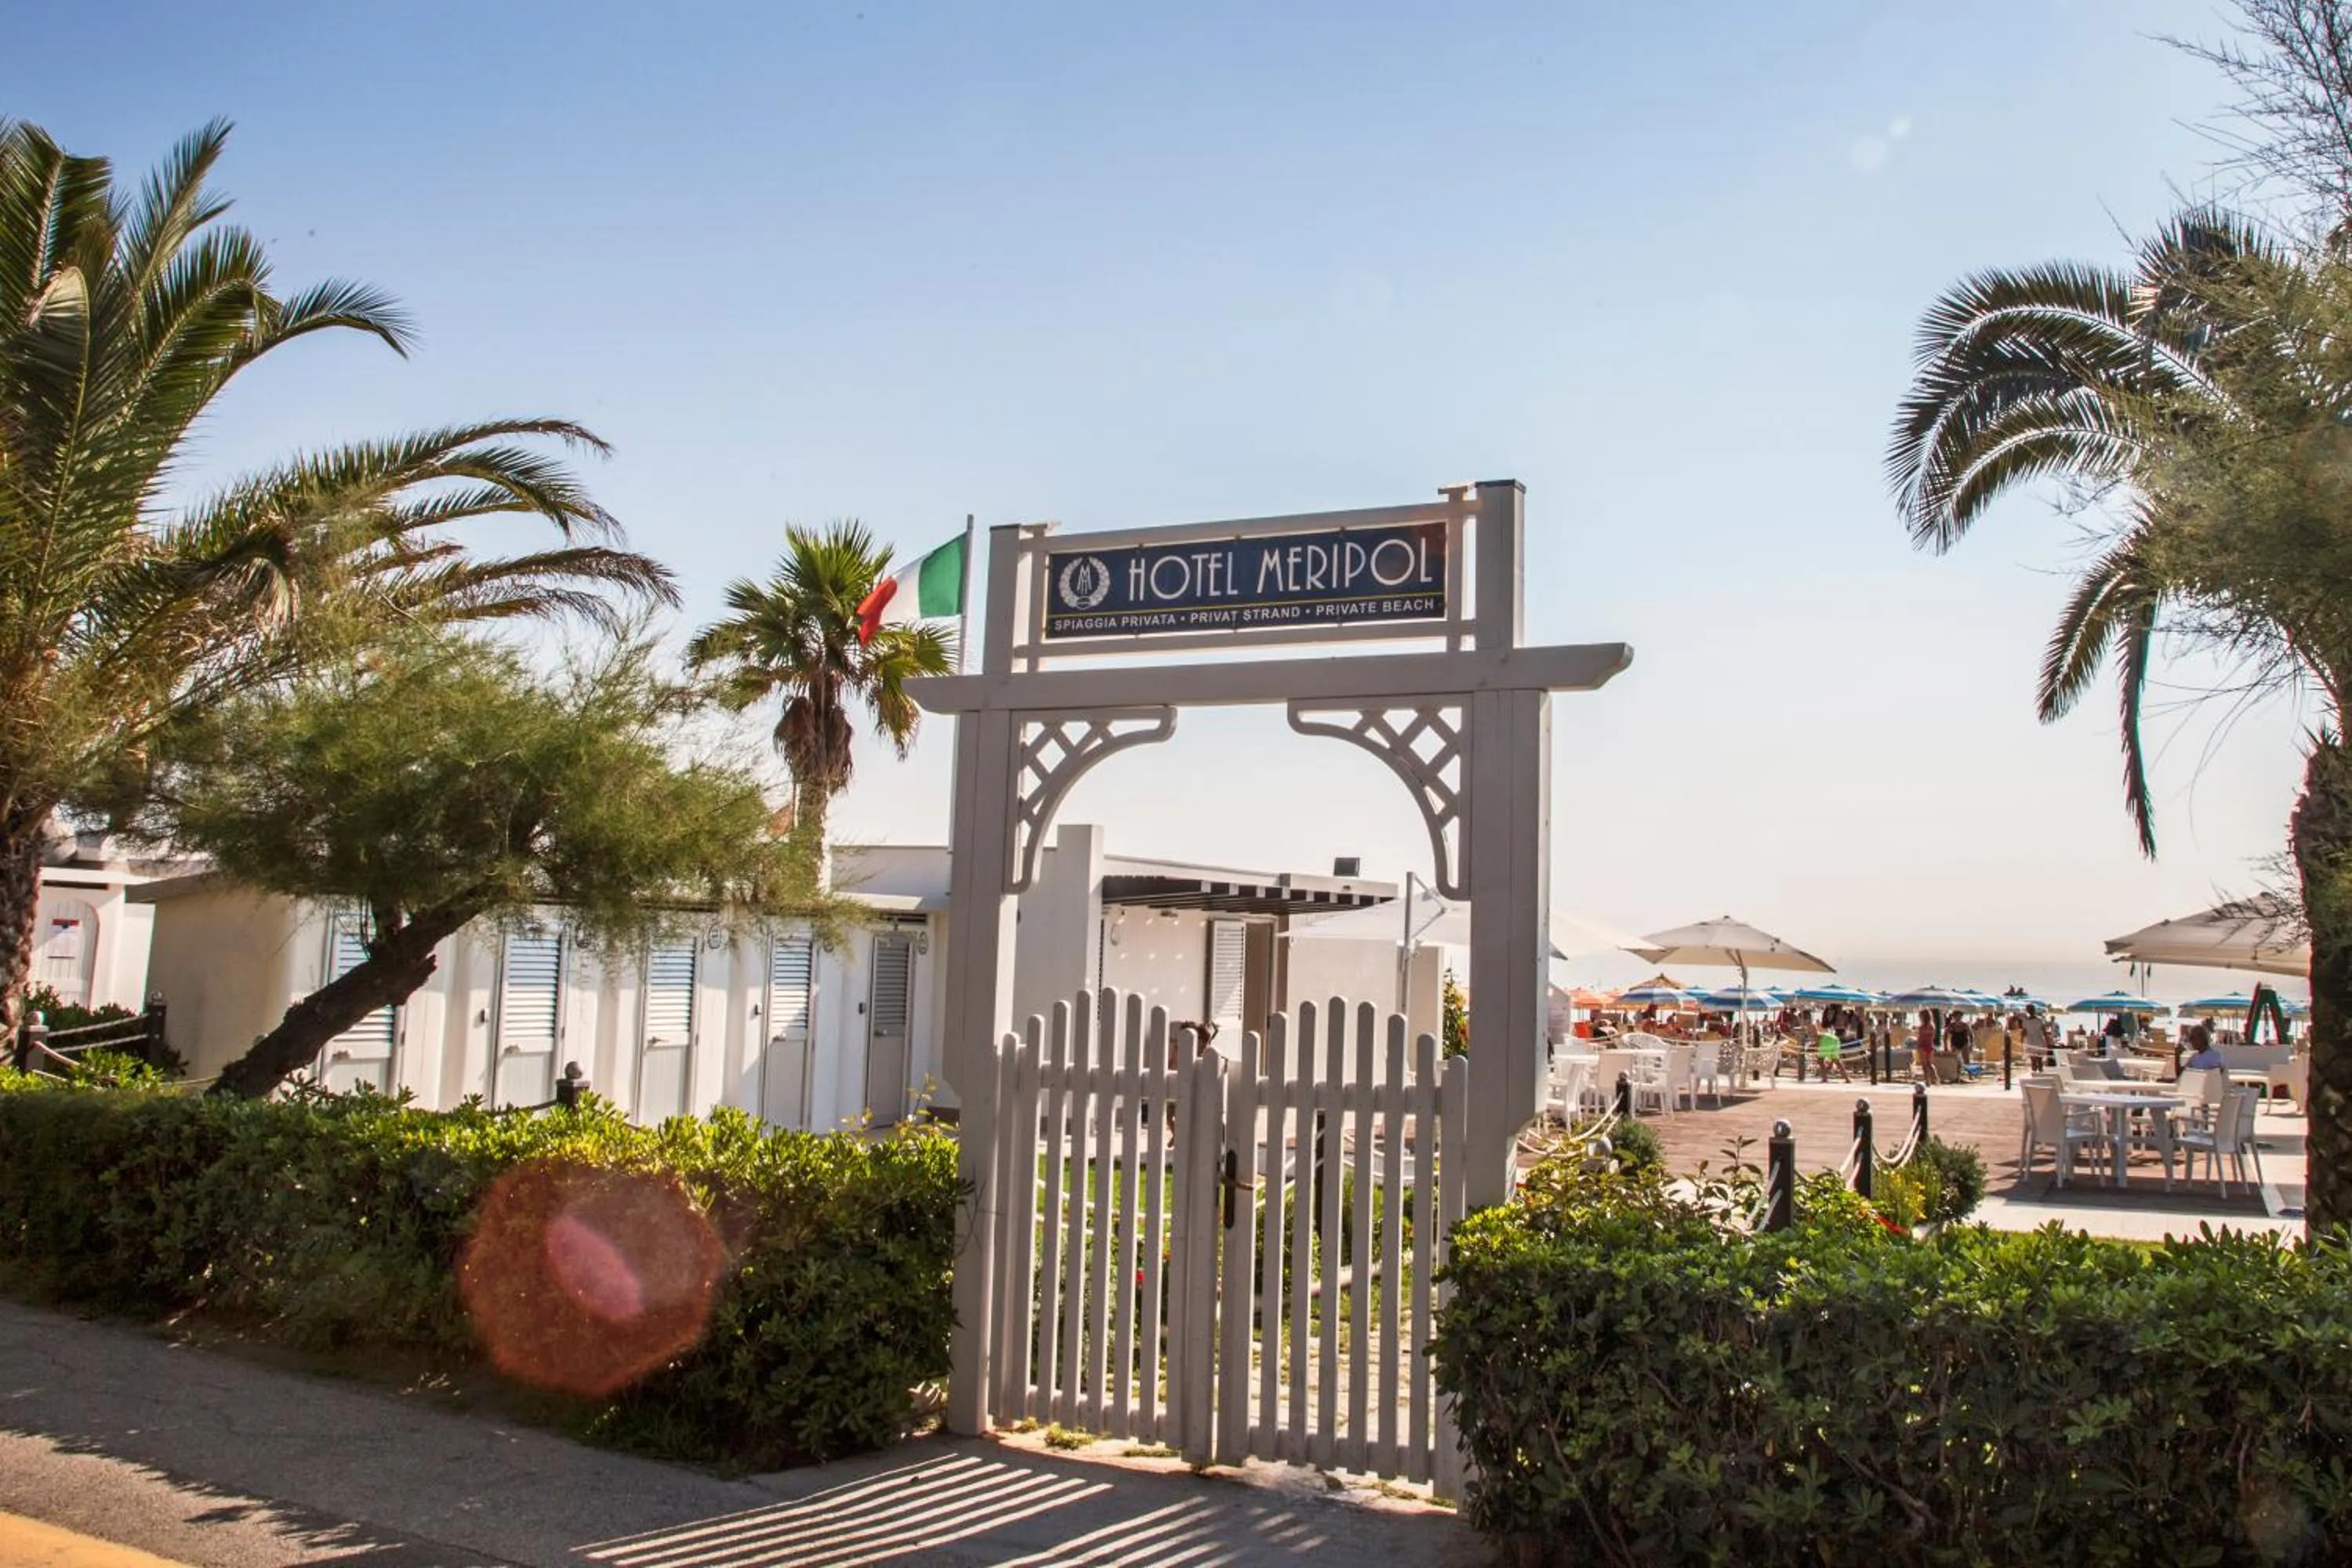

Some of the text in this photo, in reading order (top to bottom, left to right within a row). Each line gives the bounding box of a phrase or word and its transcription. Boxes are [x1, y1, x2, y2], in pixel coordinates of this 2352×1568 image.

[1128, 551, 1239, 601] HOTEL
[1257, 537, 1433, 593] MERIPOL
[1054, 598, 1435, 630] SPIAGGIA PRIVATA PRIVAT STRAND PRIVATE BEACH
